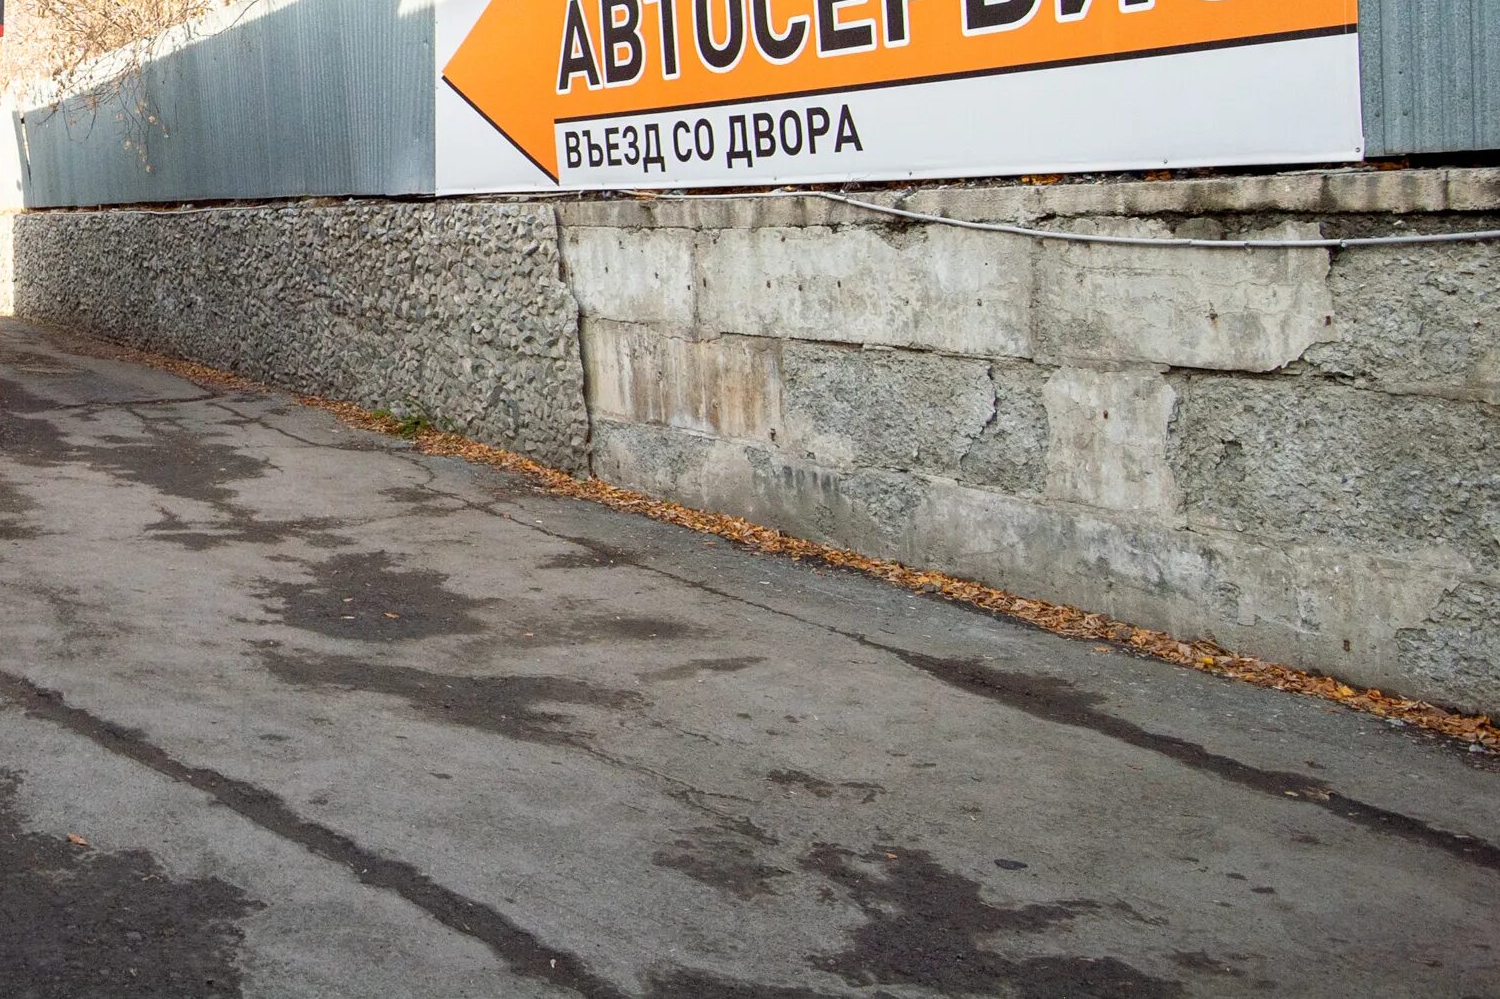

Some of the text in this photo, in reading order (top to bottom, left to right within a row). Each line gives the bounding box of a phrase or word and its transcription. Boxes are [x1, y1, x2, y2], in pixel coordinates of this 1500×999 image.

[565, 104, 863, 173] ВЪЕЗД СО ДВОРА
